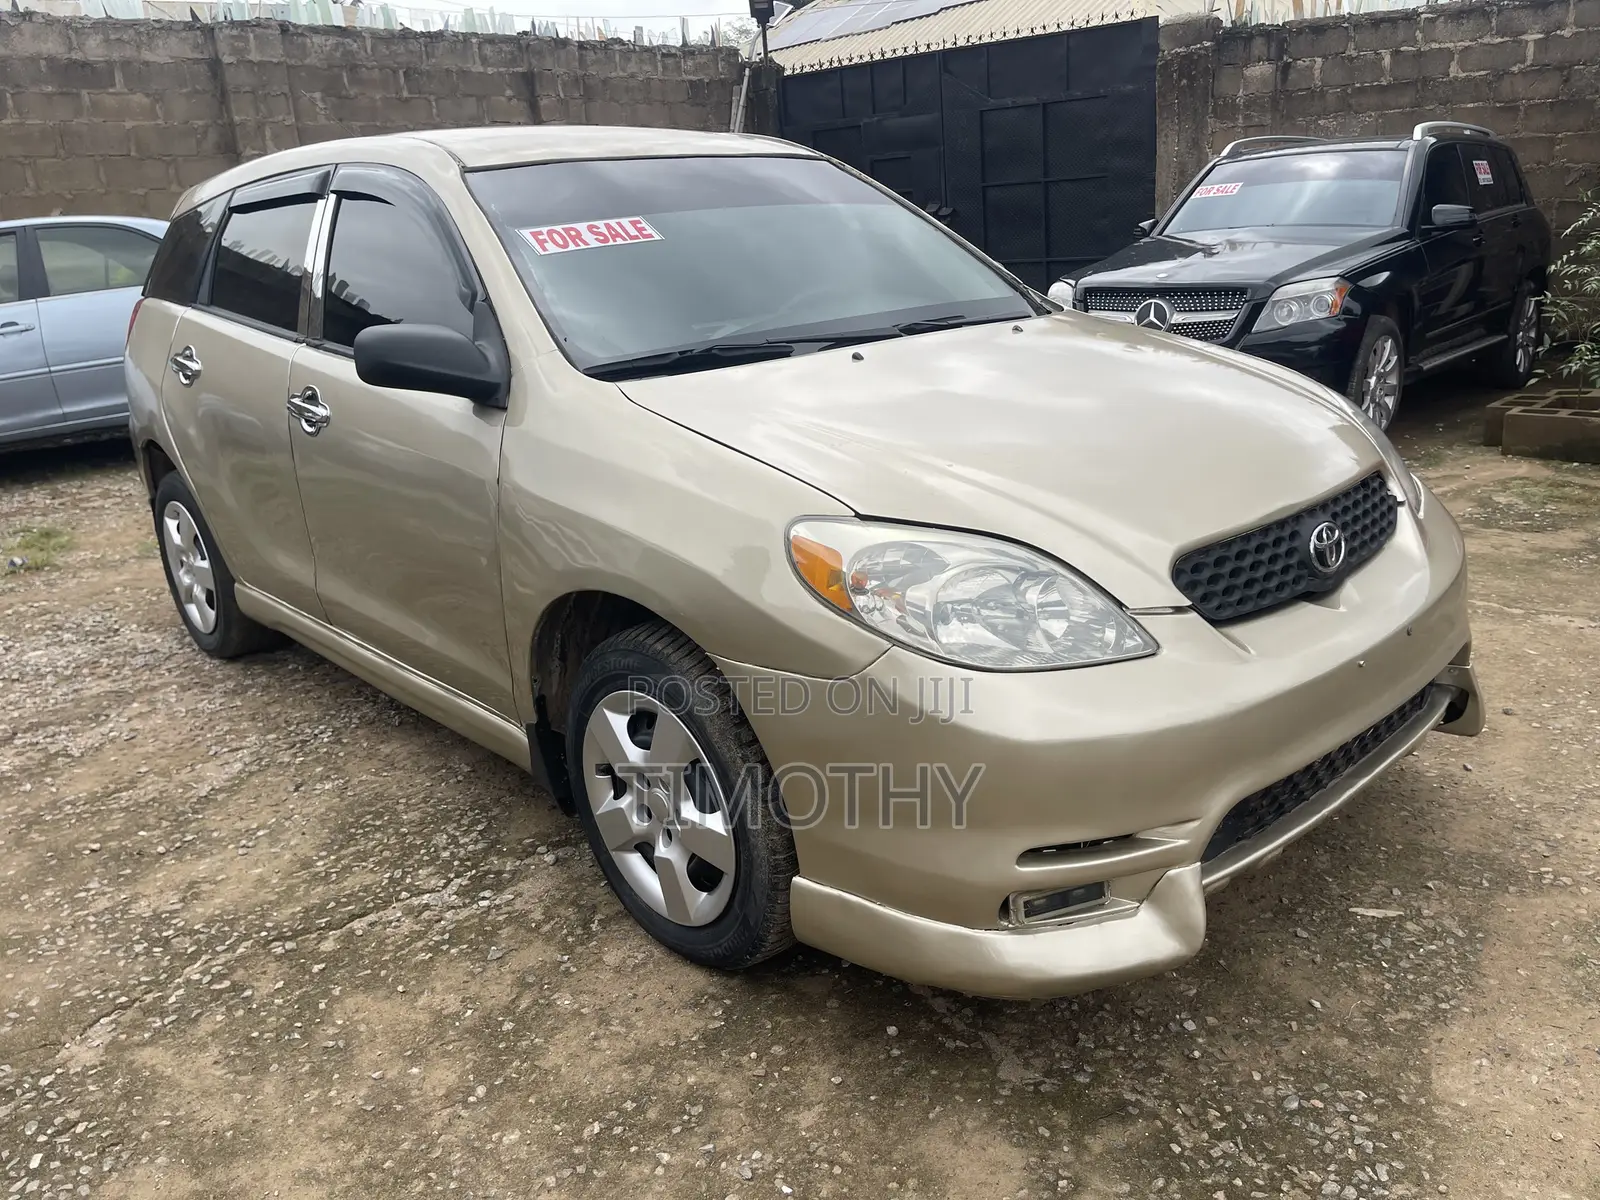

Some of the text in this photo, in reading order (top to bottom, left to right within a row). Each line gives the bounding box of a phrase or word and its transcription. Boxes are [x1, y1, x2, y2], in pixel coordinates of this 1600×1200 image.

[1194, 184, 1239, 197] FOR SALE
[529, 219, 655, 252] FOR SALE
[576, 656, 642, 700] DGESTONE
